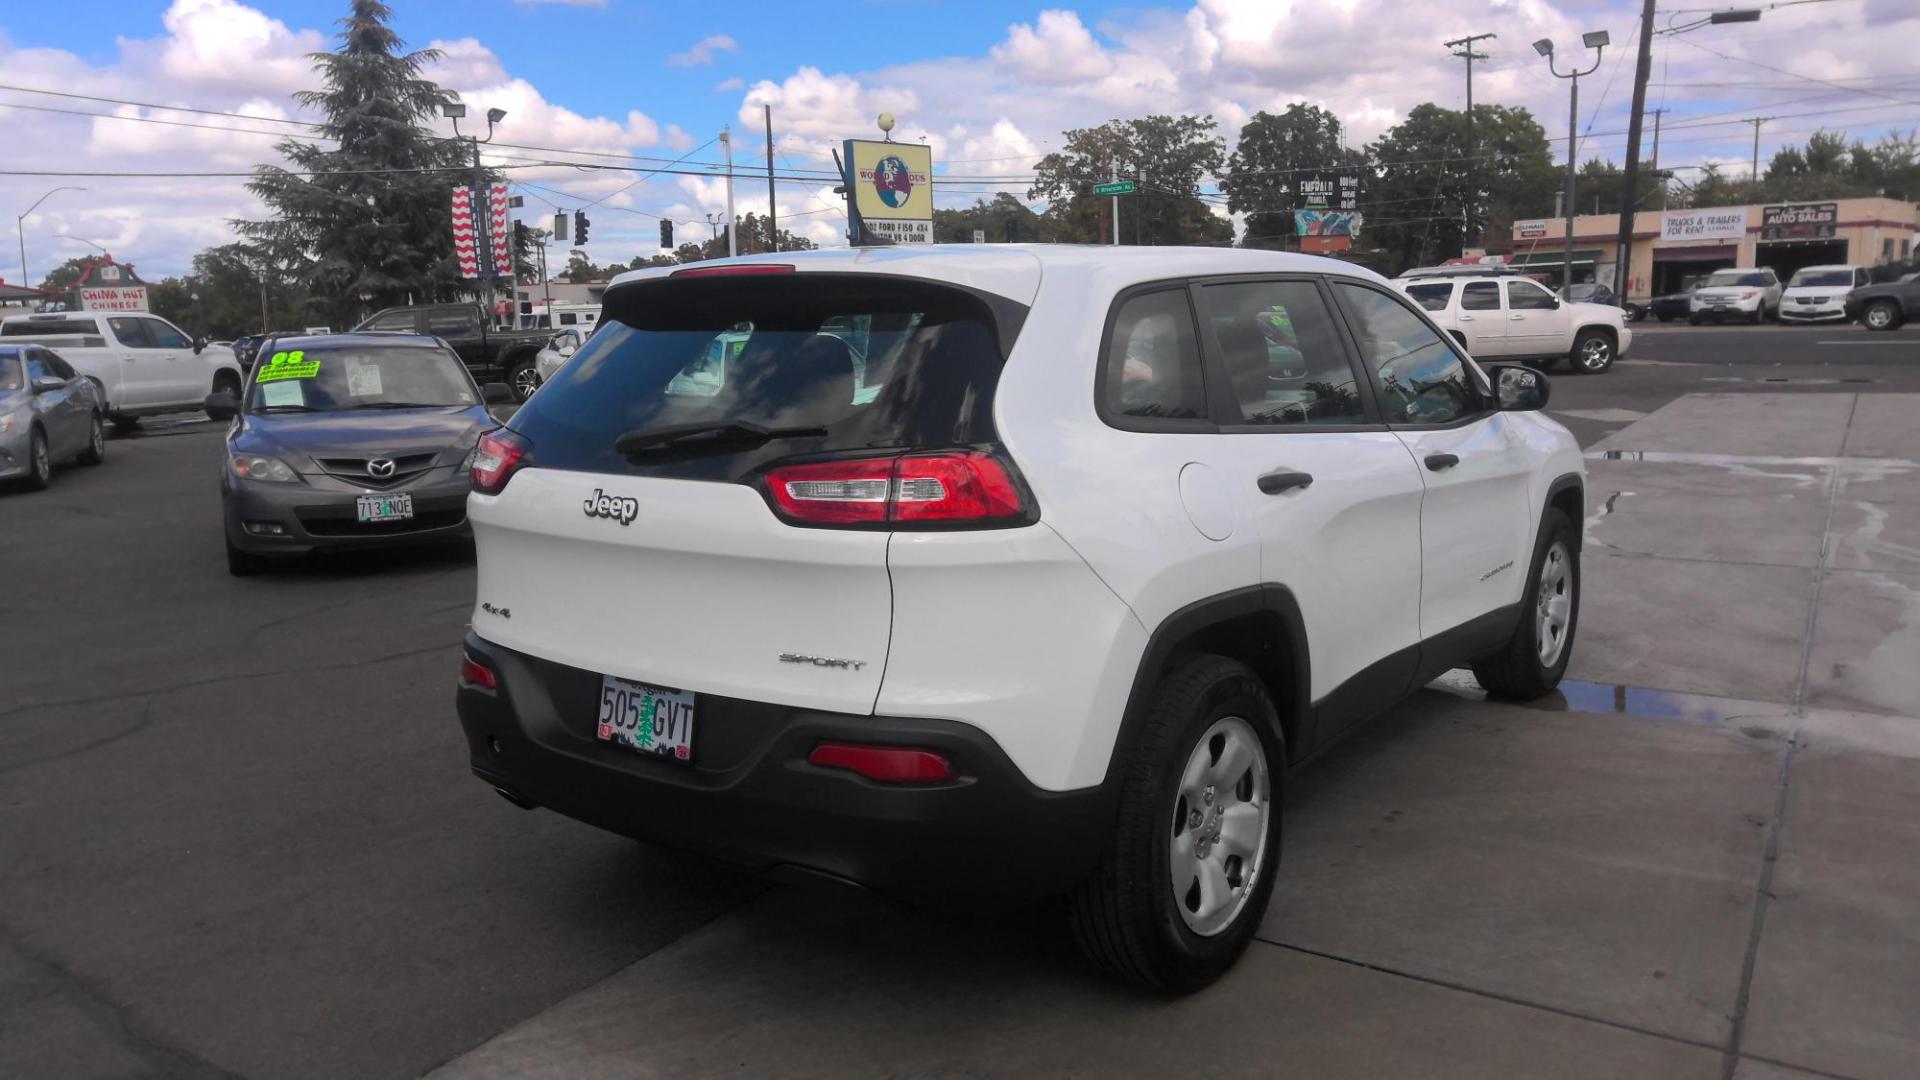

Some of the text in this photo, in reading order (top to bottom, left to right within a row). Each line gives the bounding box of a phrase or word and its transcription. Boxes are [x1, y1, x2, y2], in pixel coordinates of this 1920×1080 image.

[1668, 217, 1694, 226] TRUCKS
[1706, 215, 1742, 225] TRAILERS
[1768, 212, 1832, 224] AUTO SALES
[879, 223, 896, 231] FORD
[1667, 227, 1682, 235] FOR
[1685, 226, 1704, 234] RENT
[909, 233, 925, 242] DOOR
[82, 289, 144, 300] CHINA HUT
[92, 302, 138, 310] CHINESE
[359, 501, 382, 517] 713
[584, 488, 638, 526] Jeep
[779, 653, 867, 671] SPORT
[602, 686, 692, 743] 505 GVT
